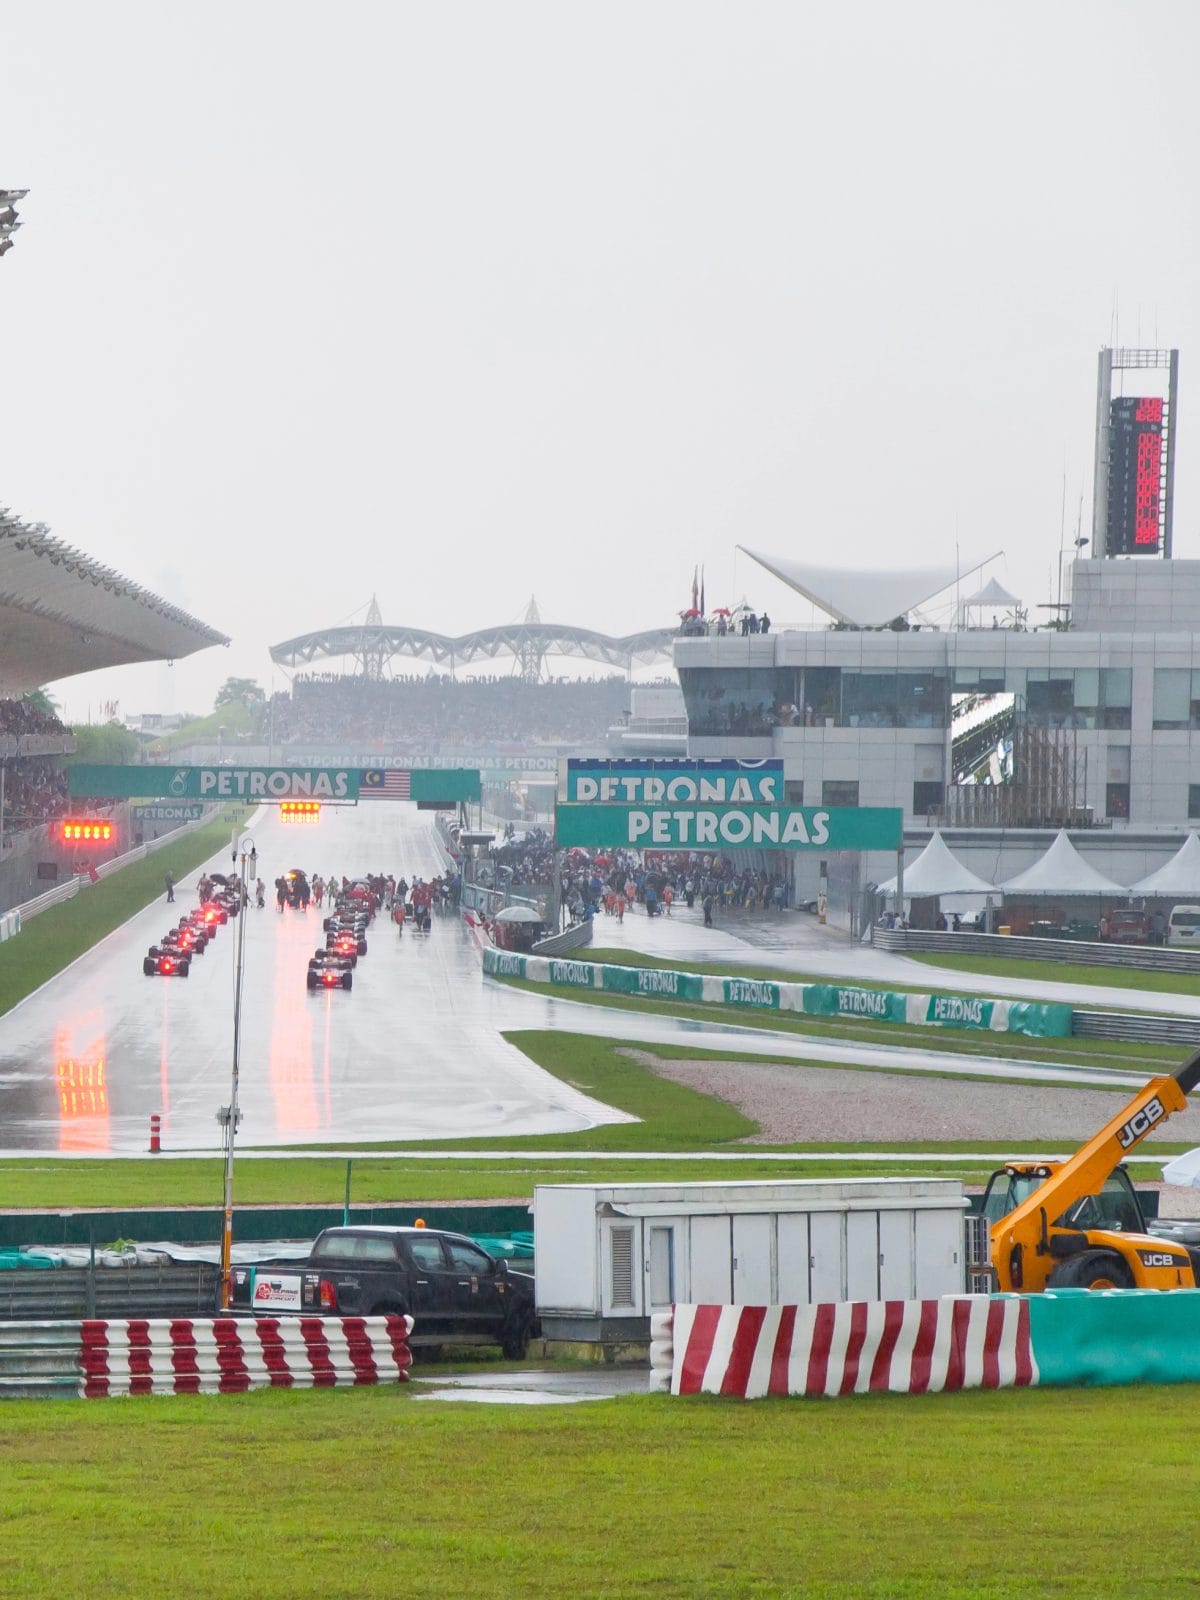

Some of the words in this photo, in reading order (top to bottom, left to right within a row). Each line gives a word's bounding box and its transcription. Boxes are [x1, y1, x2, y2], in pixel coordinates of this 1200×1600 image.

[200, 771, 348, 797] PETRONAS
[136, 807, 199, 818] PETRONAS
[628, 811, 830, 845] PETRONAS
[553, 961, 589, 985] PETRONAS
[638, 968, 679, 994] PETRONAS
[729, 982, 774, 1005] PETRONAS
[838, 988, 887, 1014] PETRONAS
[934, 996, 982, 1023] PETRONAS
[1120, 1099, 1164, 1148] JCB
[1144, 1254, 1173, 1266] JCB
